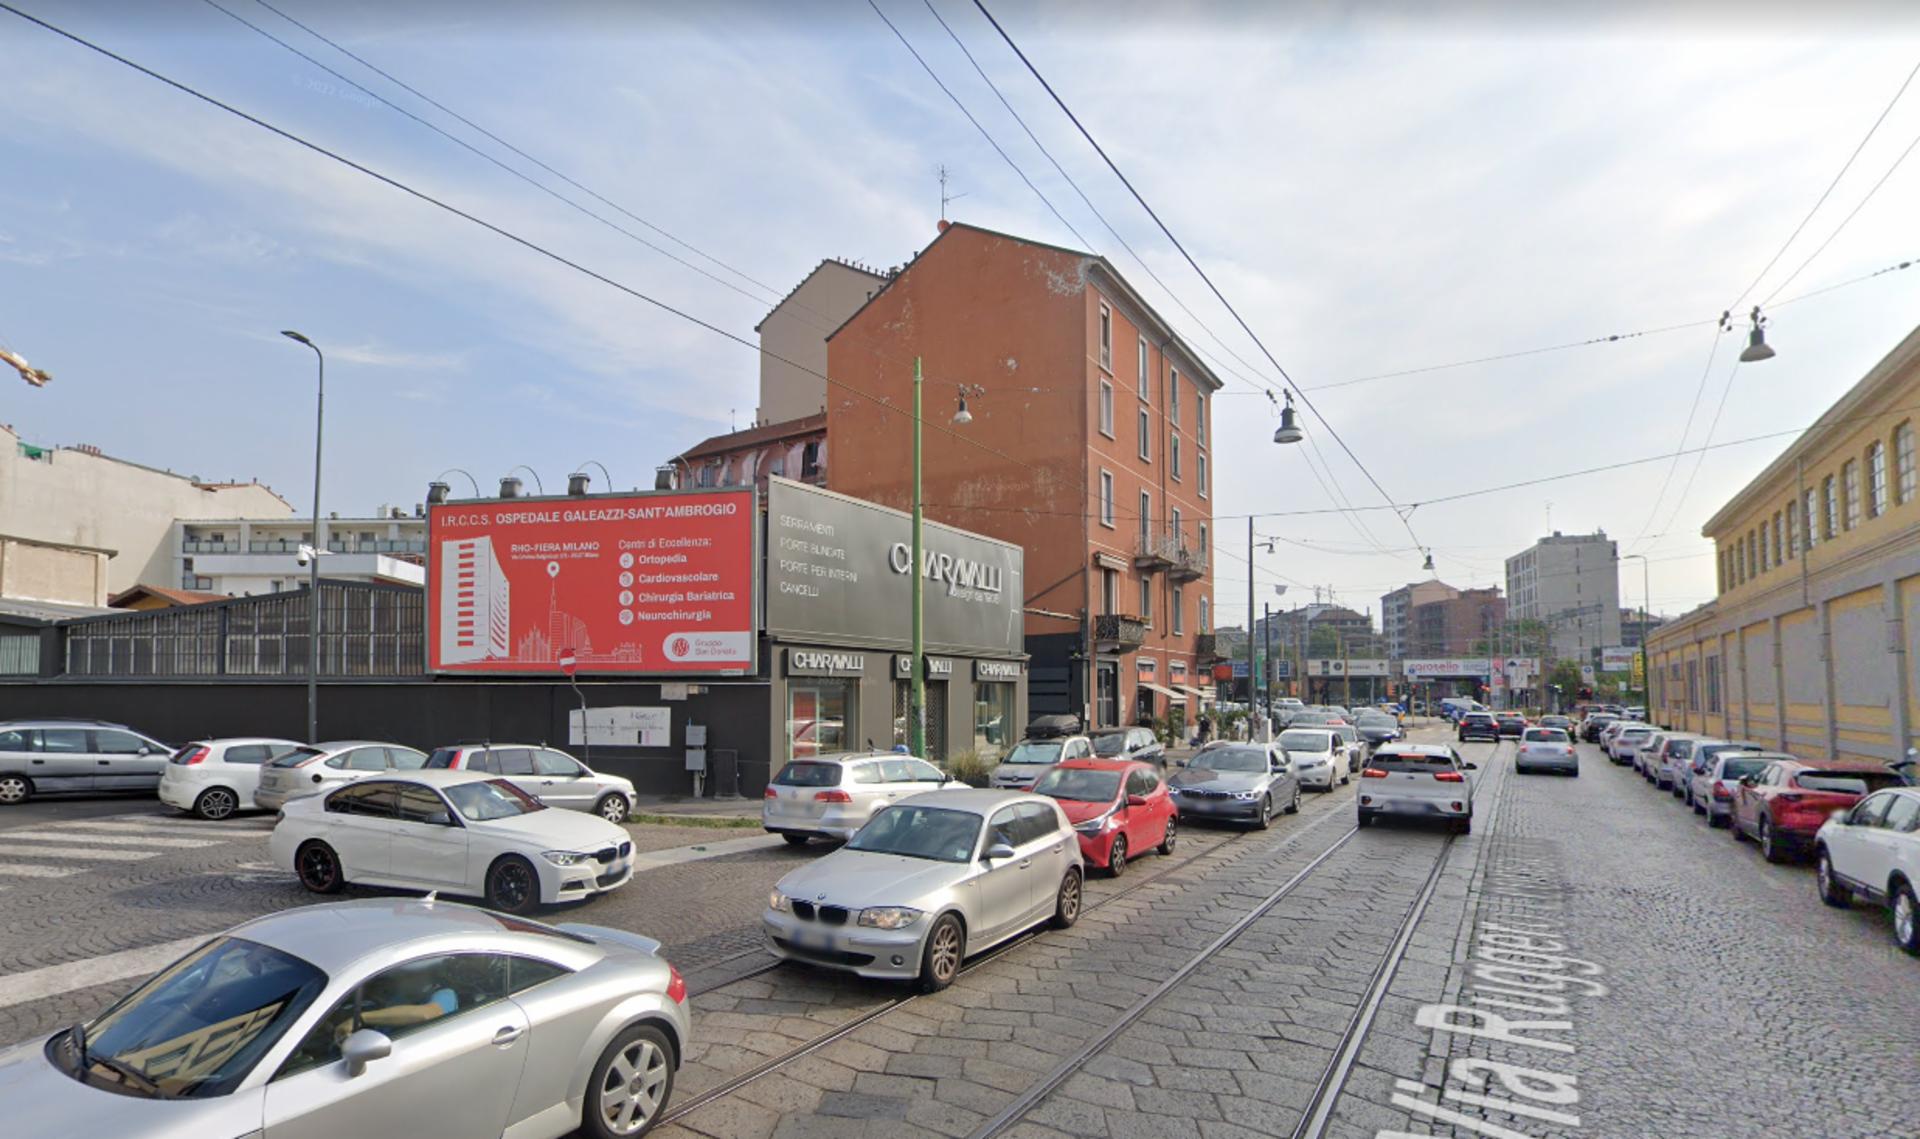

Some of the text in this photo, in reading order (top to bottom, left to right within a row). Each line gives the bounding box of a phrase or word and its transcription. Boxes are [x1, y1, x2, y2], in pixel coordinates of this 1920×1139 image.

[441, 503, 736, 527] I.R.C.C.S. OSPEDALE GALEAZZI-SANT'AMBROGIO
[563, 541, 600, 551] MILANO
[780, 537, 809, 553] PORTE
[639, 553, 687, 565] Ortopedia
[780, 559, 808, 575] PORTE
[638, 572, 719, 584] Cardiovascolare
[780, 581, 819, 597] CANCELLI
[638, 591, 735, 604] Chirurgia Bariatrica
[637, 610, 712, 622] Neurochirurgia
